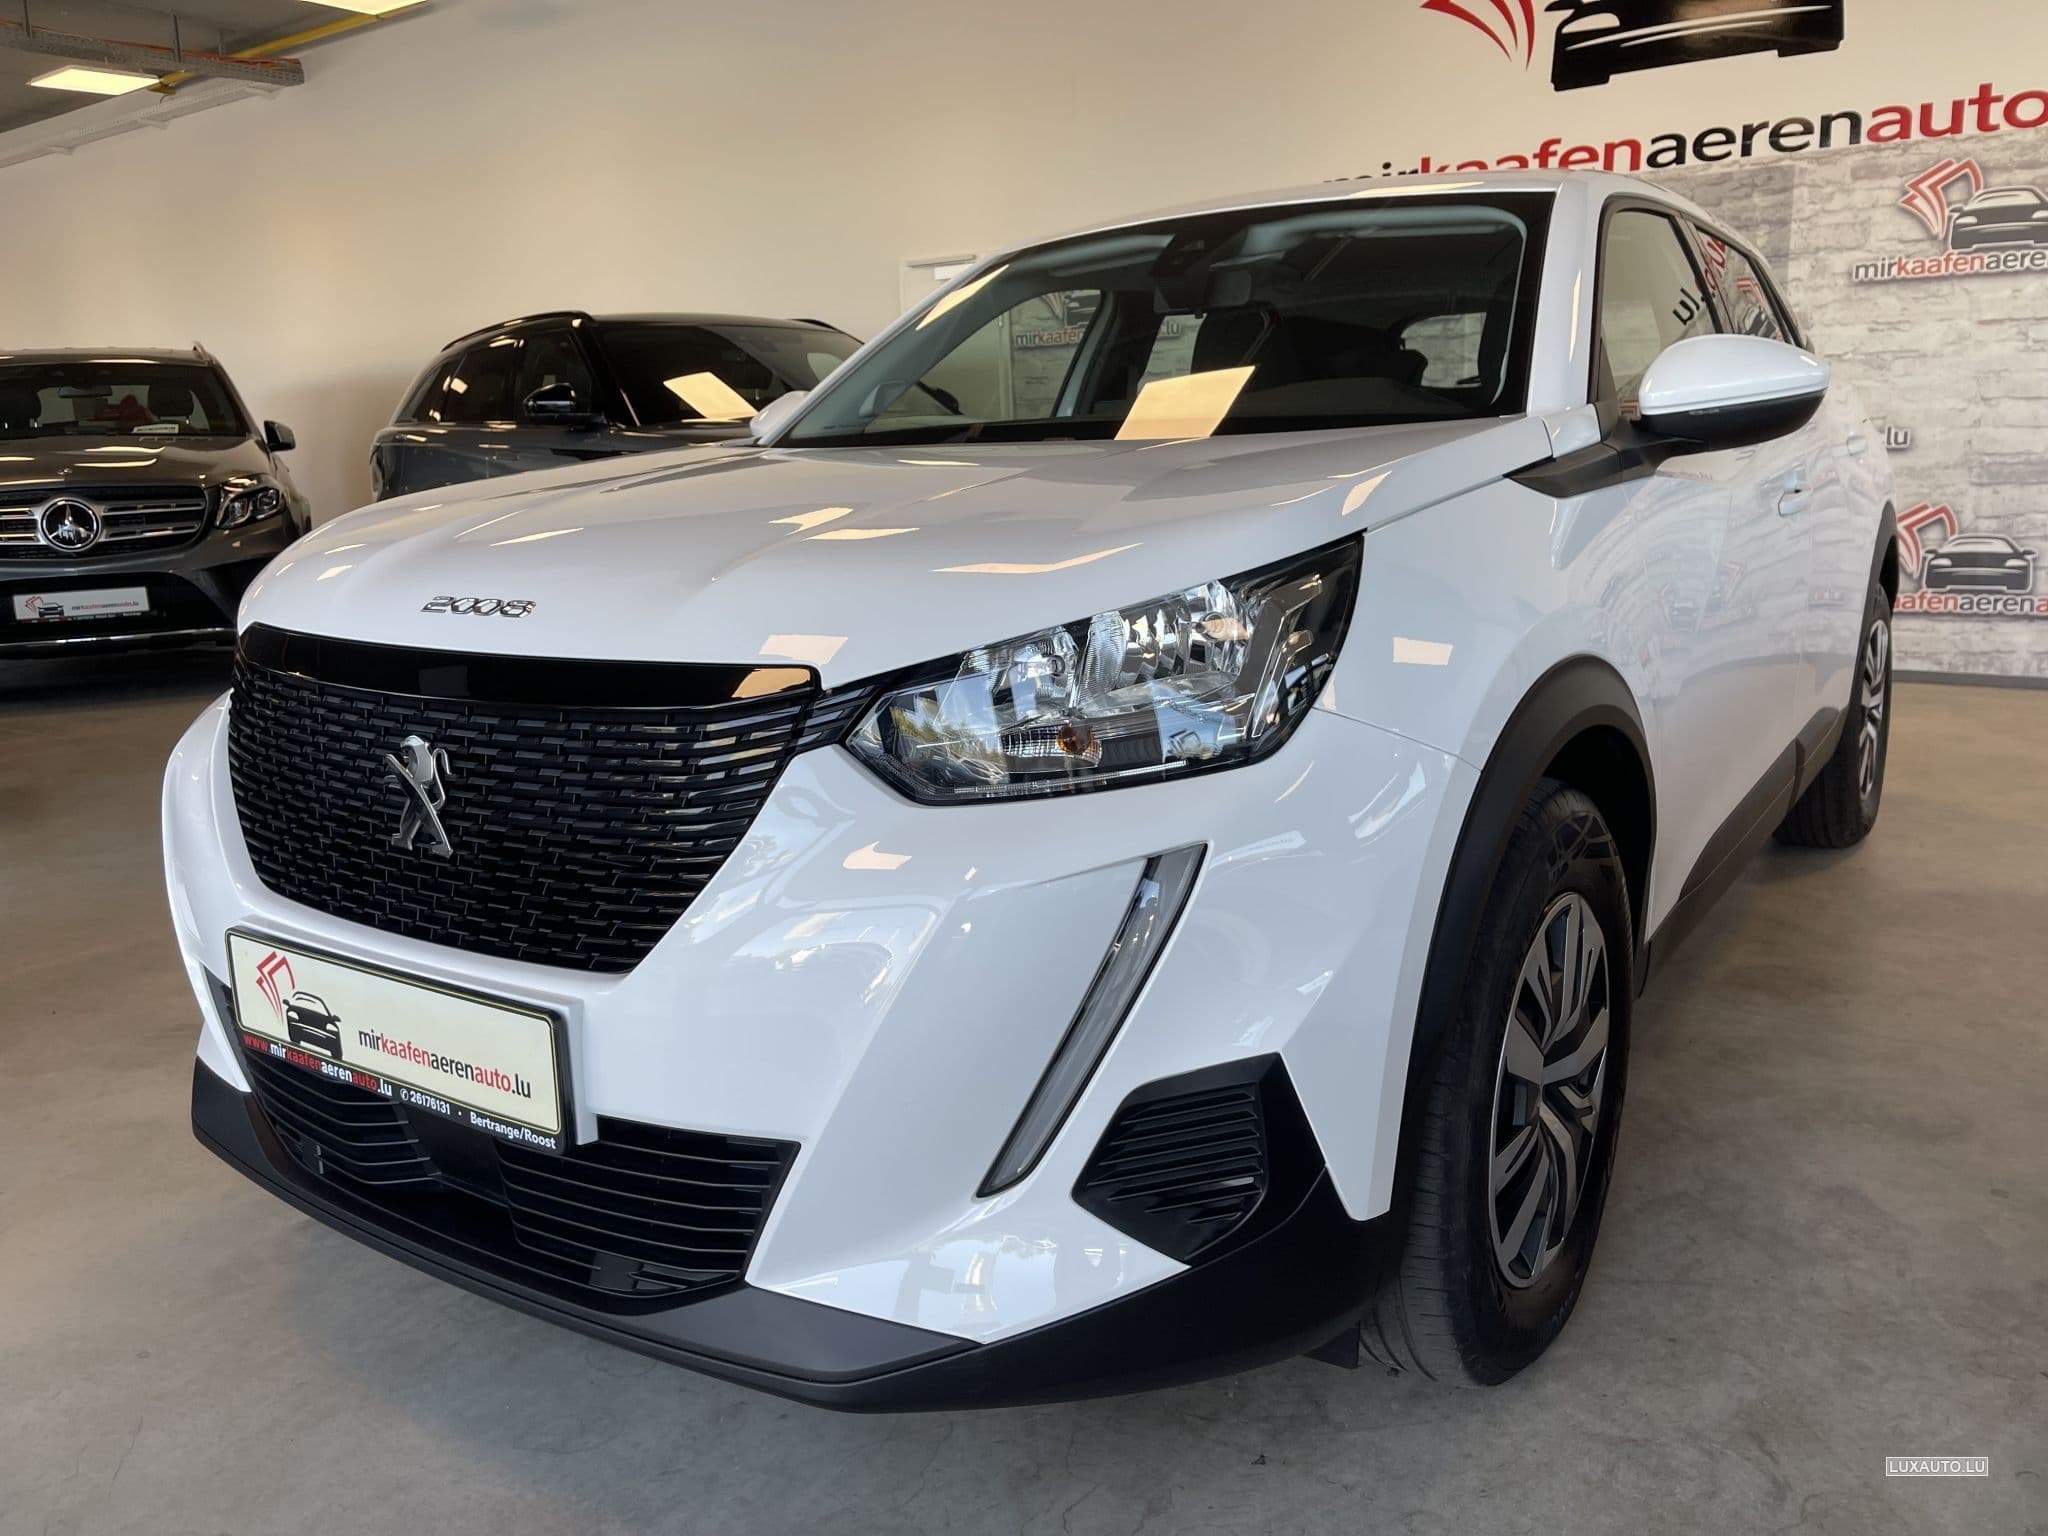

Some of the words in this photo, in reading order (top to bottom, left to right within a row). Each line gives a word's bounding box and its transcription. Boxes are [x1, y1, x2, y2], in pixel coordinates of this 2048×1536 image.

[1323, 83, 2048, 183] fenaerenauto
[421, 596, 536, 618] 2008
[358, 1028, 532, 1099] mirkaafenaerenauto.lu
[409, 1090, 451, 1115] 26176131
[469, 1111, 557, 1150] Bertrange/Roost
